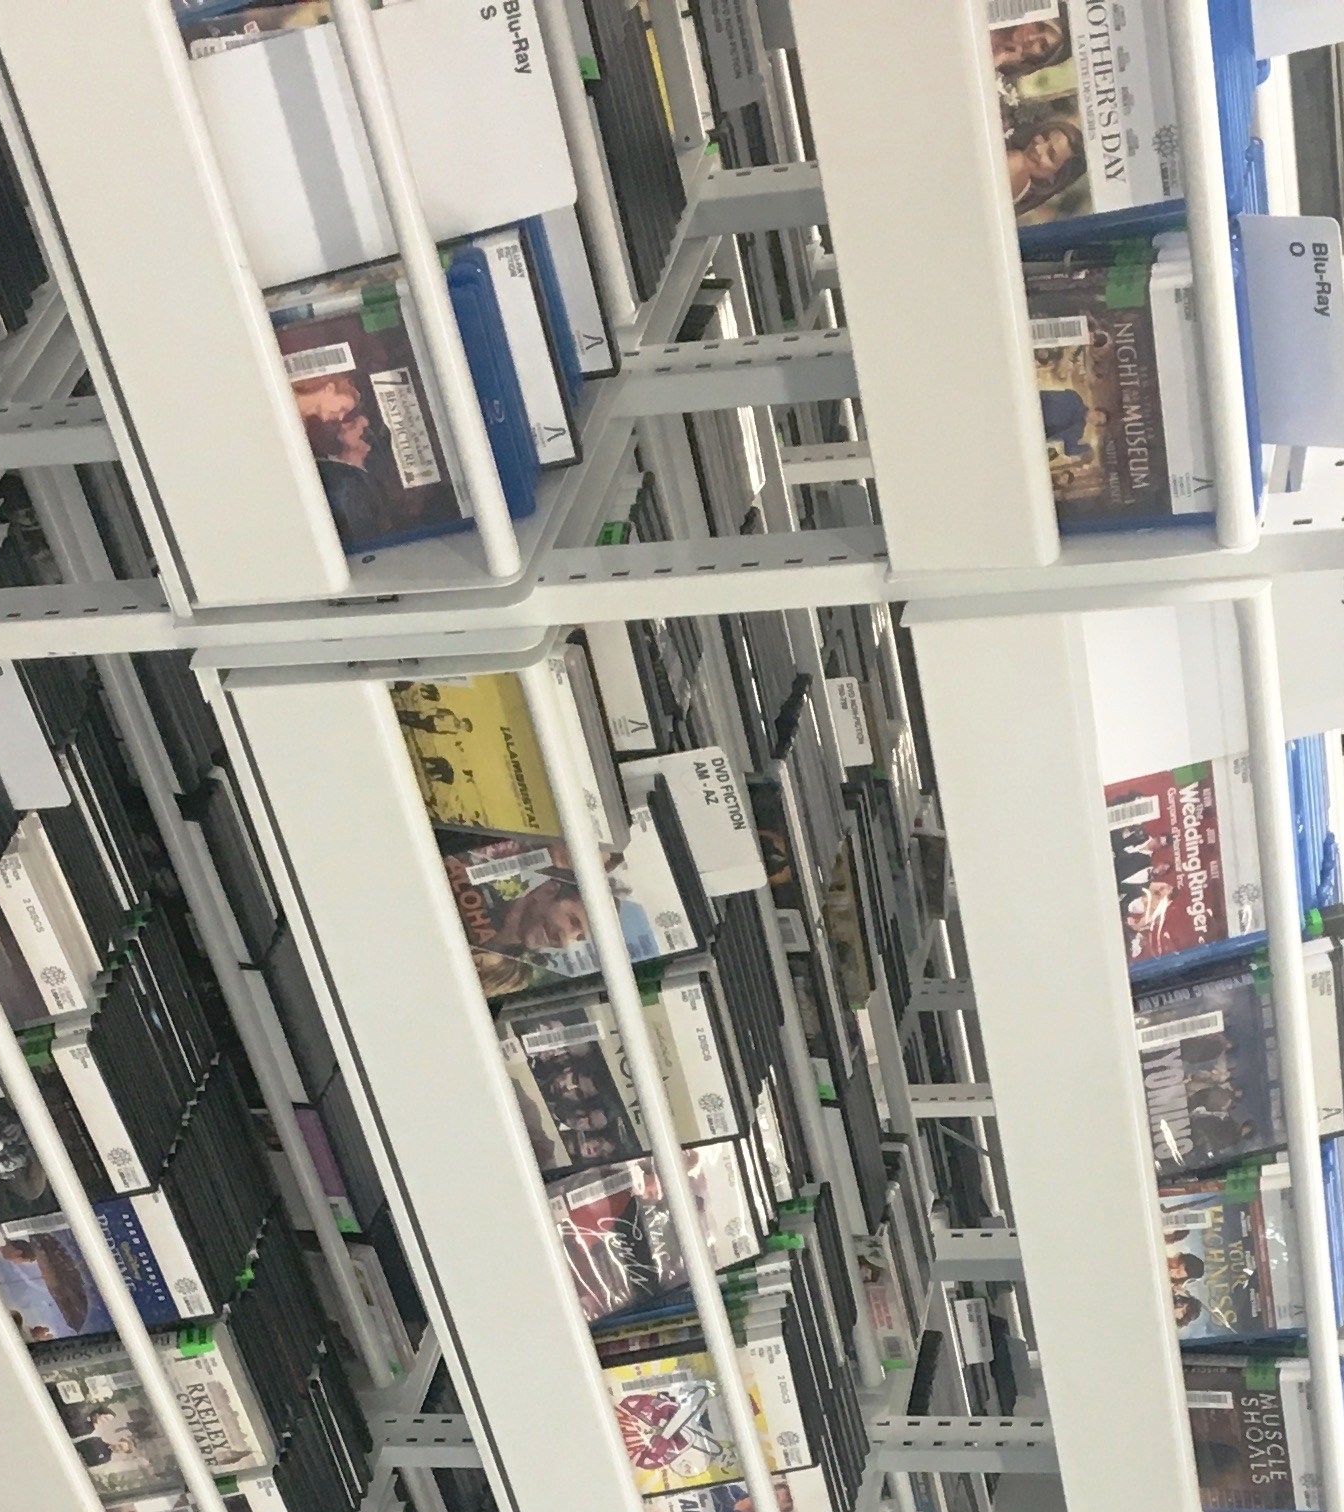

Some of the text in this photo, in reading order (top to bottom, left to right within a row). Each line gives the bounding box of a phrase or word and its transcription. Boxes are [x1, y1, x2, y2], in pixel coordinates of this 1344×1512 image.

[480, 4, 498, 21] S
[503, 0, 532, 75] Blu-Ray
[1085, 0, 1121, 129] OTHER'S
[1100, 133, 1127, 184] DAY
[1289, 241, 1306, 258] O
[1312, 243, 1332, 317] Blu-Ray
[373, 371, 409, 387] 7
[1113, 322, 1140, 387] NIGHT
[386, 390, 415, 469] BEST PICTURE
[1120, 404, 1150, 489] MUSEUM
[693, 761, 711, 781] AM
[704, 789, 718, 806] AZ
[711, 757, 746, 831] DVD FICTION
[1178, 782, 1209, 933] Wedding Ringer
[22, 897, 45, 934] 2 DISCS
[443, 857, 496, 946] ALOHA
[698, 1034, 712, 1062] DISCS
[1202, 1204, 1238, 1327] HIGHNESS
[1227, 1240, 1247, 1293] YOUR
[186, 1383, 231, 1451] RKELEY
[1240, 1396, 1270, 1485] SHOALS
[1257, 1393, 1288, 1481] MUSCLE
